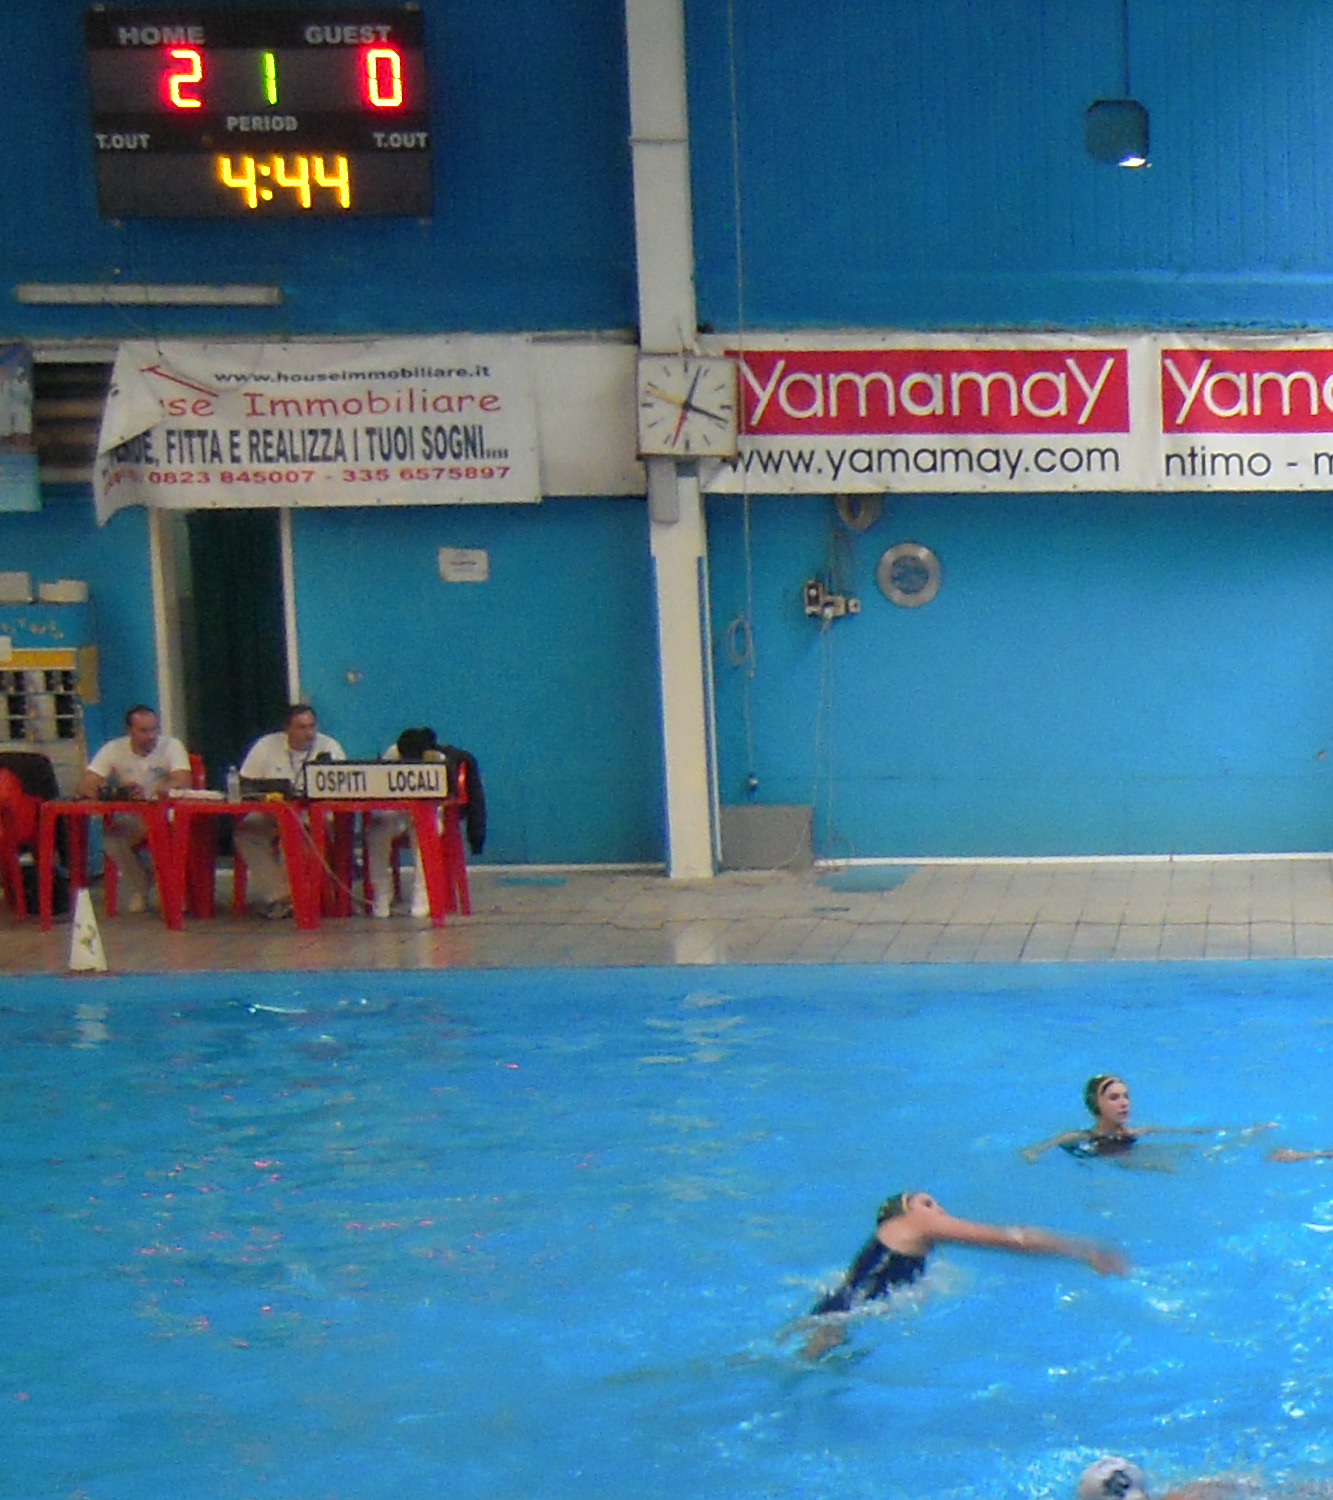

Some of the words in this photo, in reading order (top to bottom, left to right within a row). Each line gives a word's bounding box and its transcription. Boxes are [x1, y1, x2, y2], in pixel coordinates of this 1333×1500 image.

[118, 26, 205, 45] HOME
[304, 25, 392, 44] GUEST
[168, 49, 203, 108] 2
[263, 52, 279, 105] 1
[365, 48, 403, 107] 0
[226, 116, 299, 132] PERIOD
[96, 133, 151, 149] T.OUT
[373, 132, 429, 148] T.OUT
[218, 156, 351, 209] 4:44
[214, 365, 491, 382] www.houseimmobiliare.it
[243, 387, 502, 417] Immobiliare
[166, 429, 223, 464] FITTA
[229, 429, 242, 464] E
[249, 428, 347, 463] REALIZZA
[366, 426, 414, 462] TUOI
[728, 446, 1120, 481] www.yamamay.com
[149, 470, 211, 485] 0823
[220, 470, 315, 484] 845007
[342, 468, 390, 482] 335
[400, 466, 511, 481] 6575897
[315, 770, 367, 792] OSPITI
[387, 770, 440, 792] LOCALI
